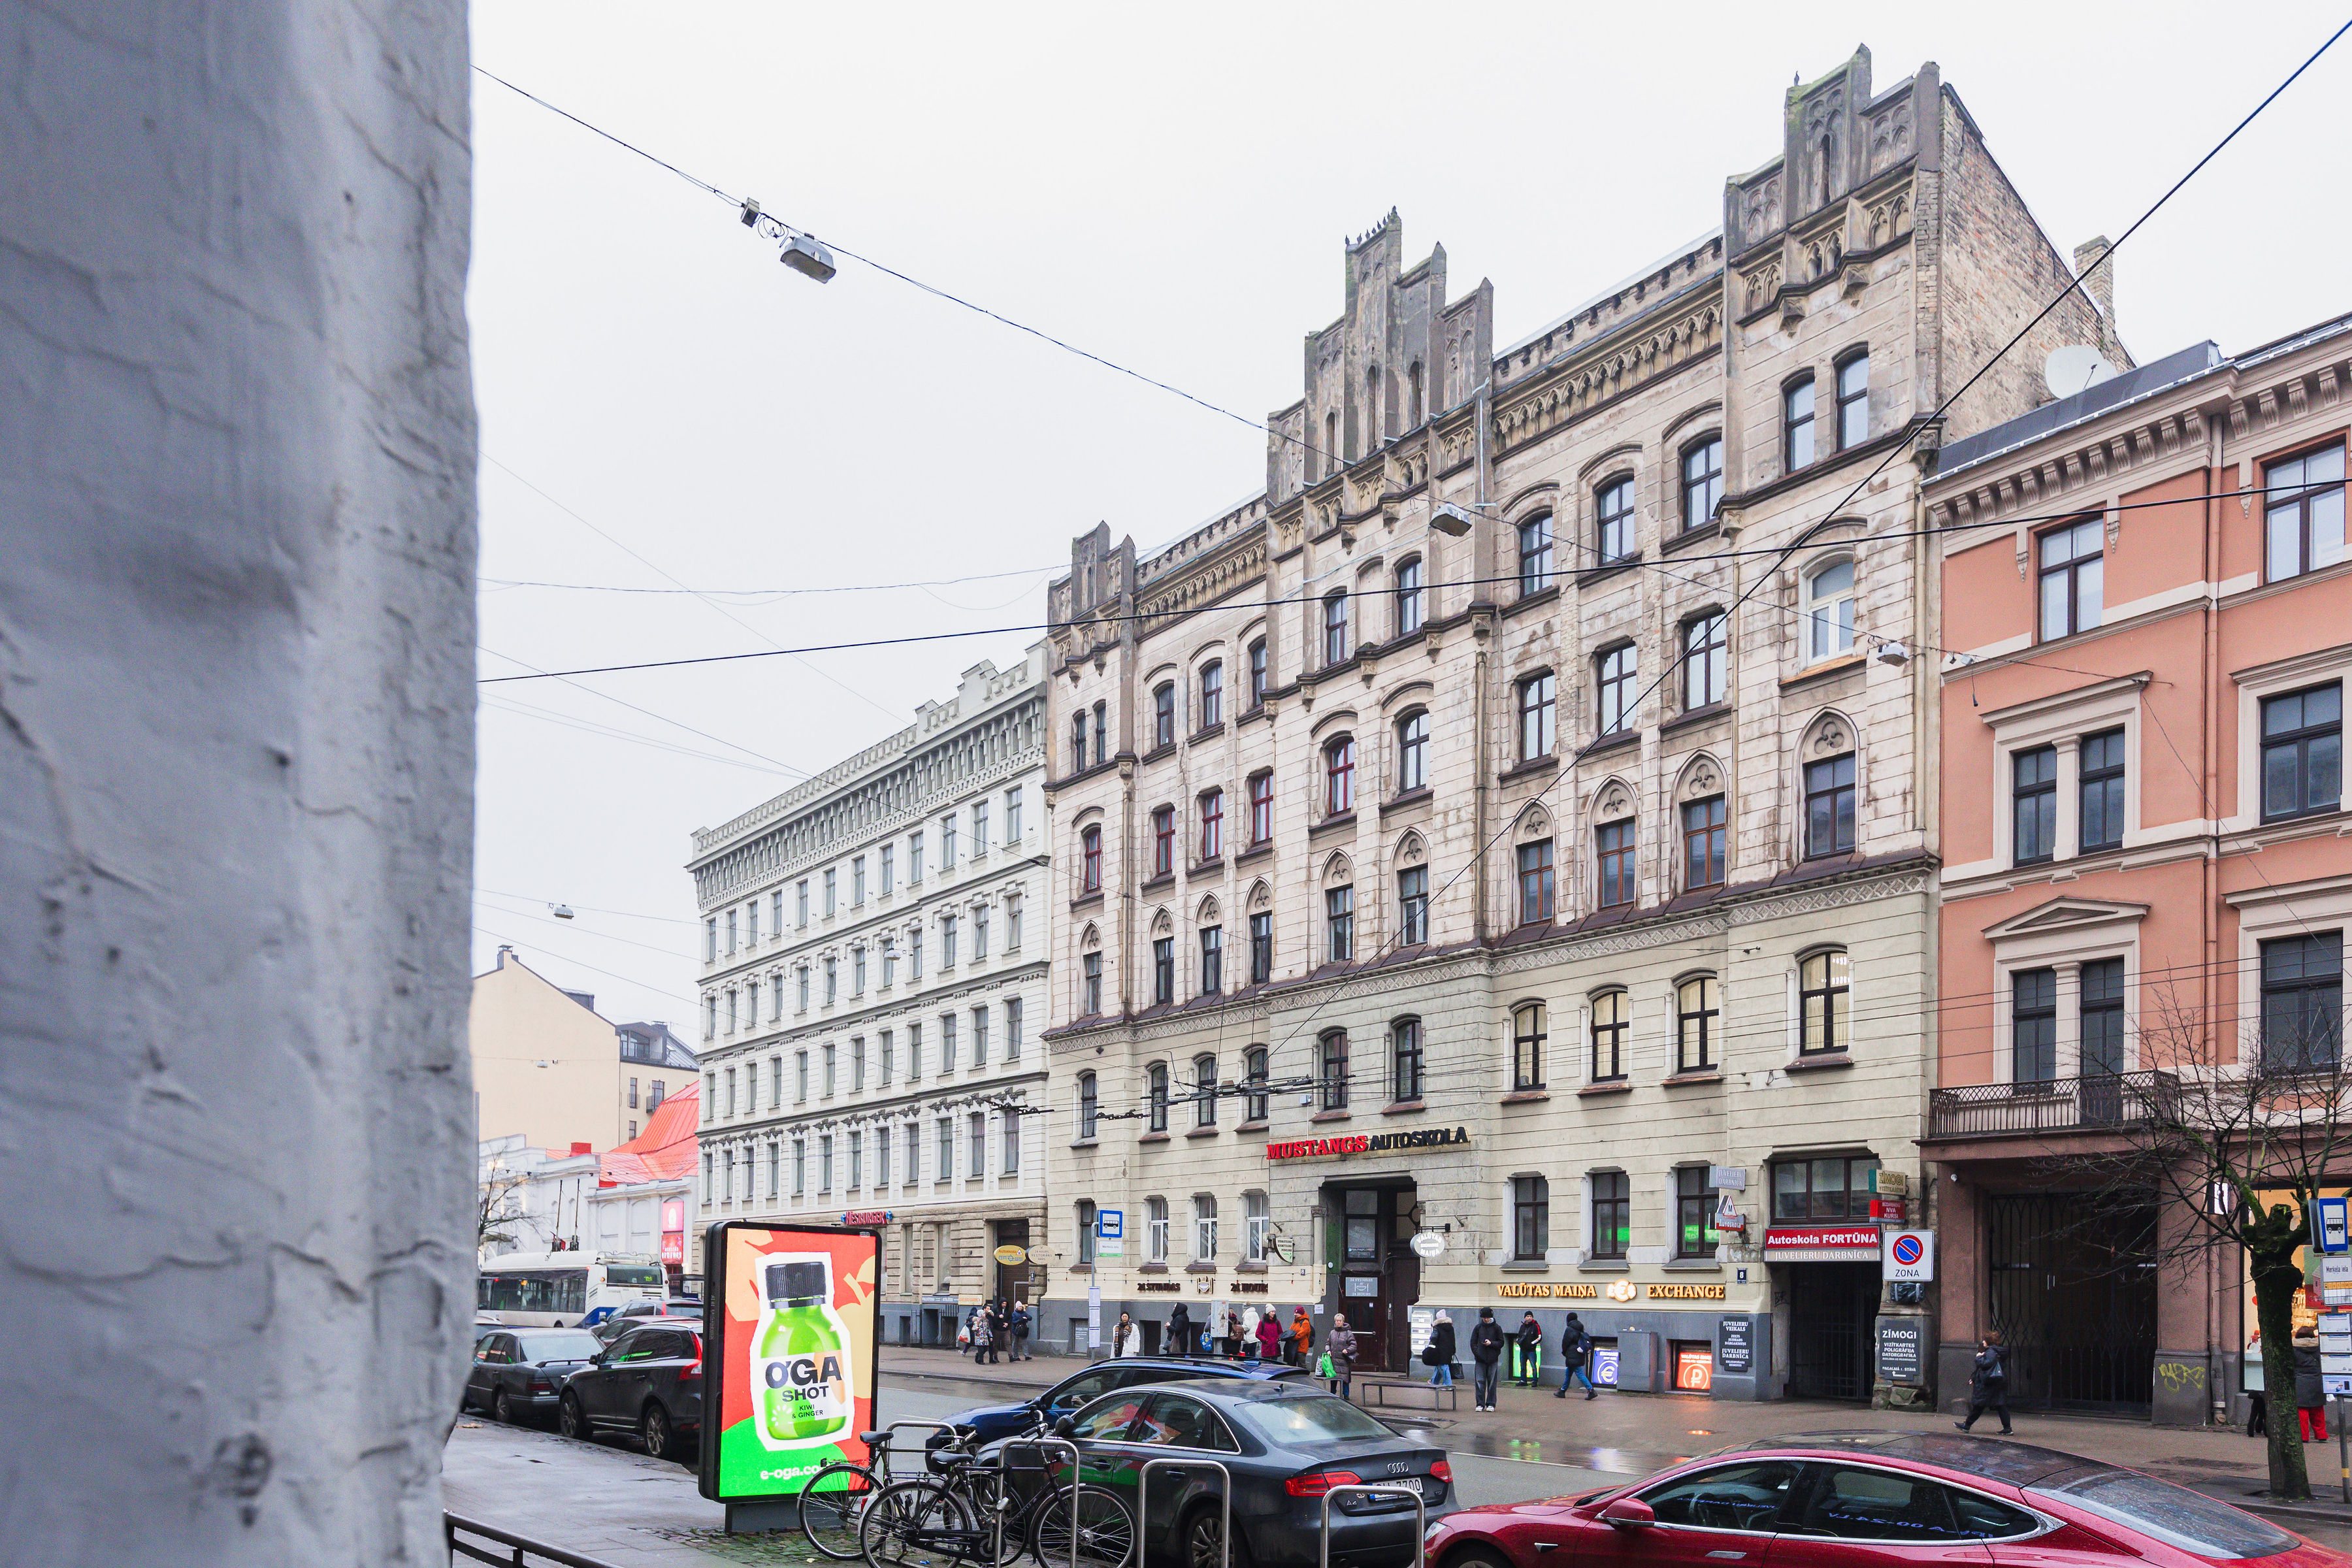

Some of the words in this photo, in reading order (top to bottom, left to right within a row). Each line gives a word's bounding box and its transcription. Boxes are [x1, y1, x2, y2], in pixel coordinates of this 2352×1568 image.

[1266, 1135, 1369, 1160] MUSTANGS
[1369, 1126, 1469, 1151] AUTOSKOLA
[1719, 1168, 1743, 1179] JUVELIERU
[845, 1210, 887, 1226] HESBURGER
[1768, 1235, 1820, 1245] Autoskola
[1823, 1232, 1878, 1243] FORTŪNA
[1775, 1250, 1820, 1262] JUVELIERU
[1822, 1249, 1869, 1260] DARBNĪCA
[1146, 1282, 1181, 1292] STUNDAS
[1497, 1282, 1550, 1297] VALŪTAS
[1553, 1284, 1597, 1298] MAIŅA
[1646, 1284, 1725, 1298] EXCHANGE
[1882, 1329, 1917, 1339] ZĪMOGI
[782, 1386, 829, 1402] SHOT
[798, 1409, 824, 1418] GINGER
